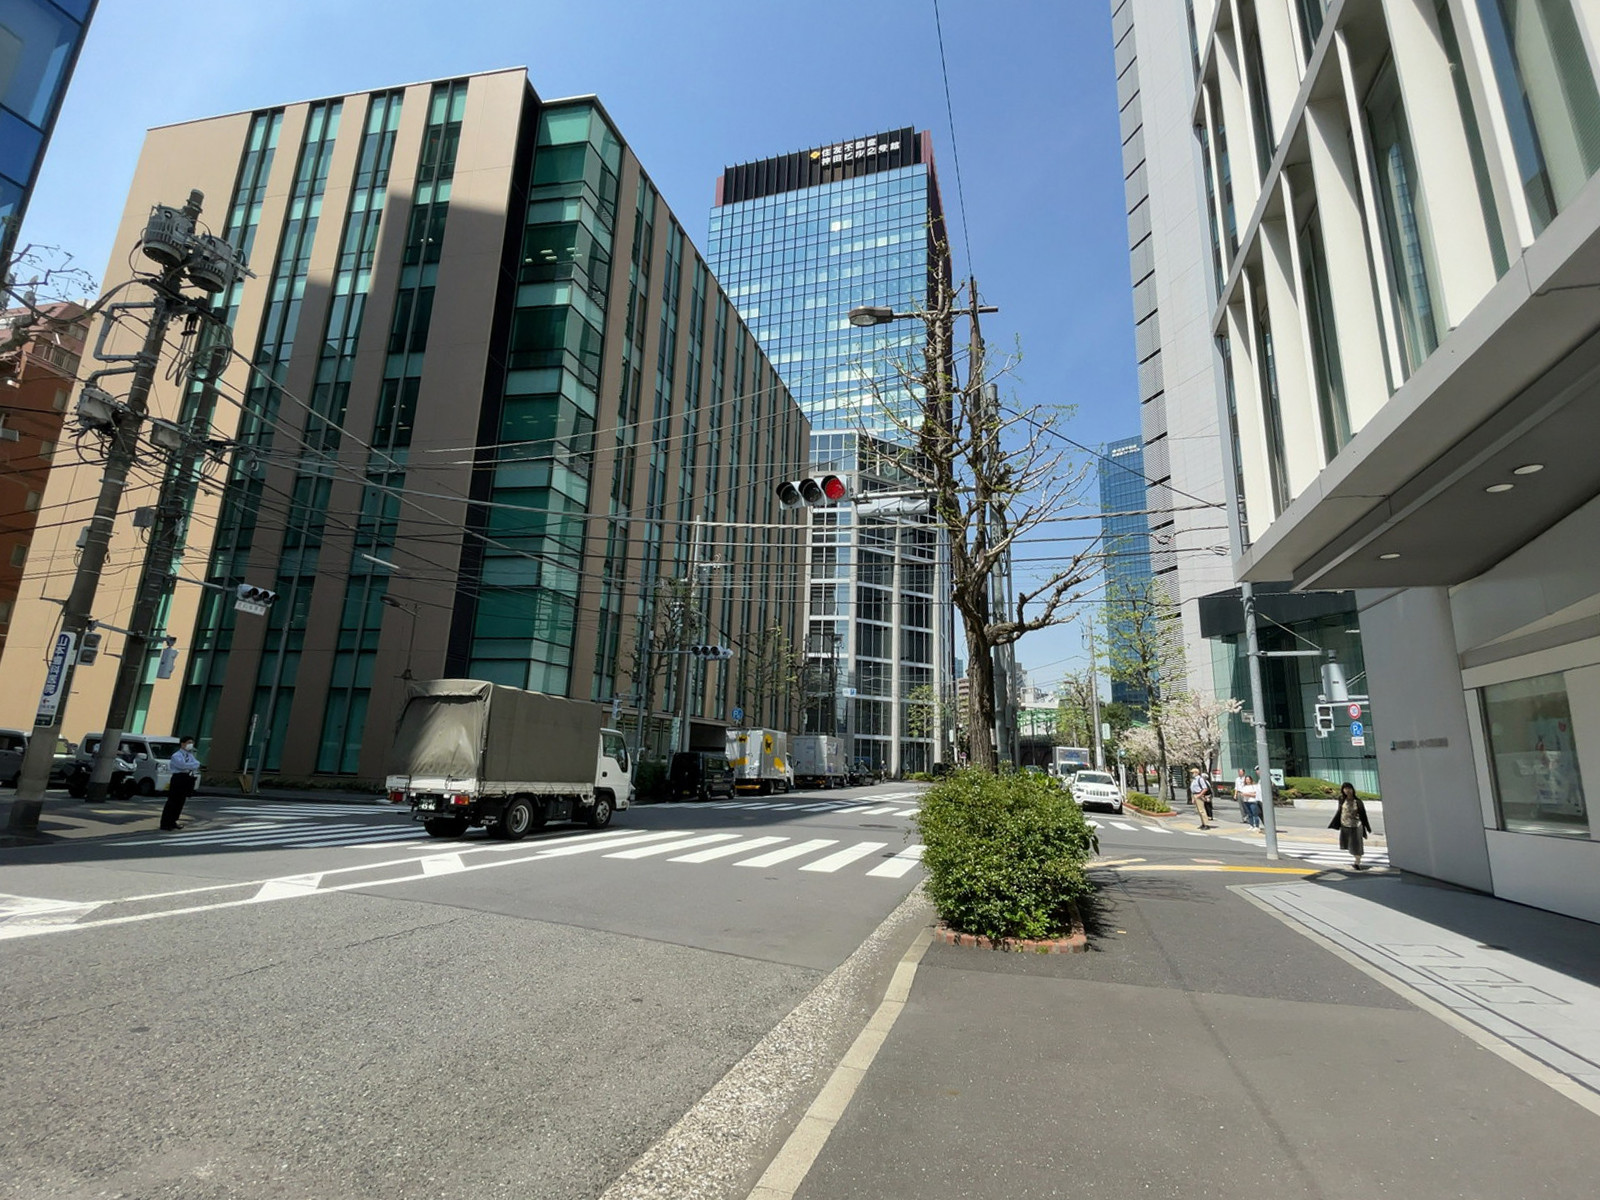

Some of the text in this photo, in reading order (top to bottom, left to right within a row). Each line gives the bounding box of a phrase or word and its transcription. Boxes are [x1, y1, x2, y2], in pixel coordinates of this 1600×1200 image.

[821, 138, 877, 158] 住友不動産
